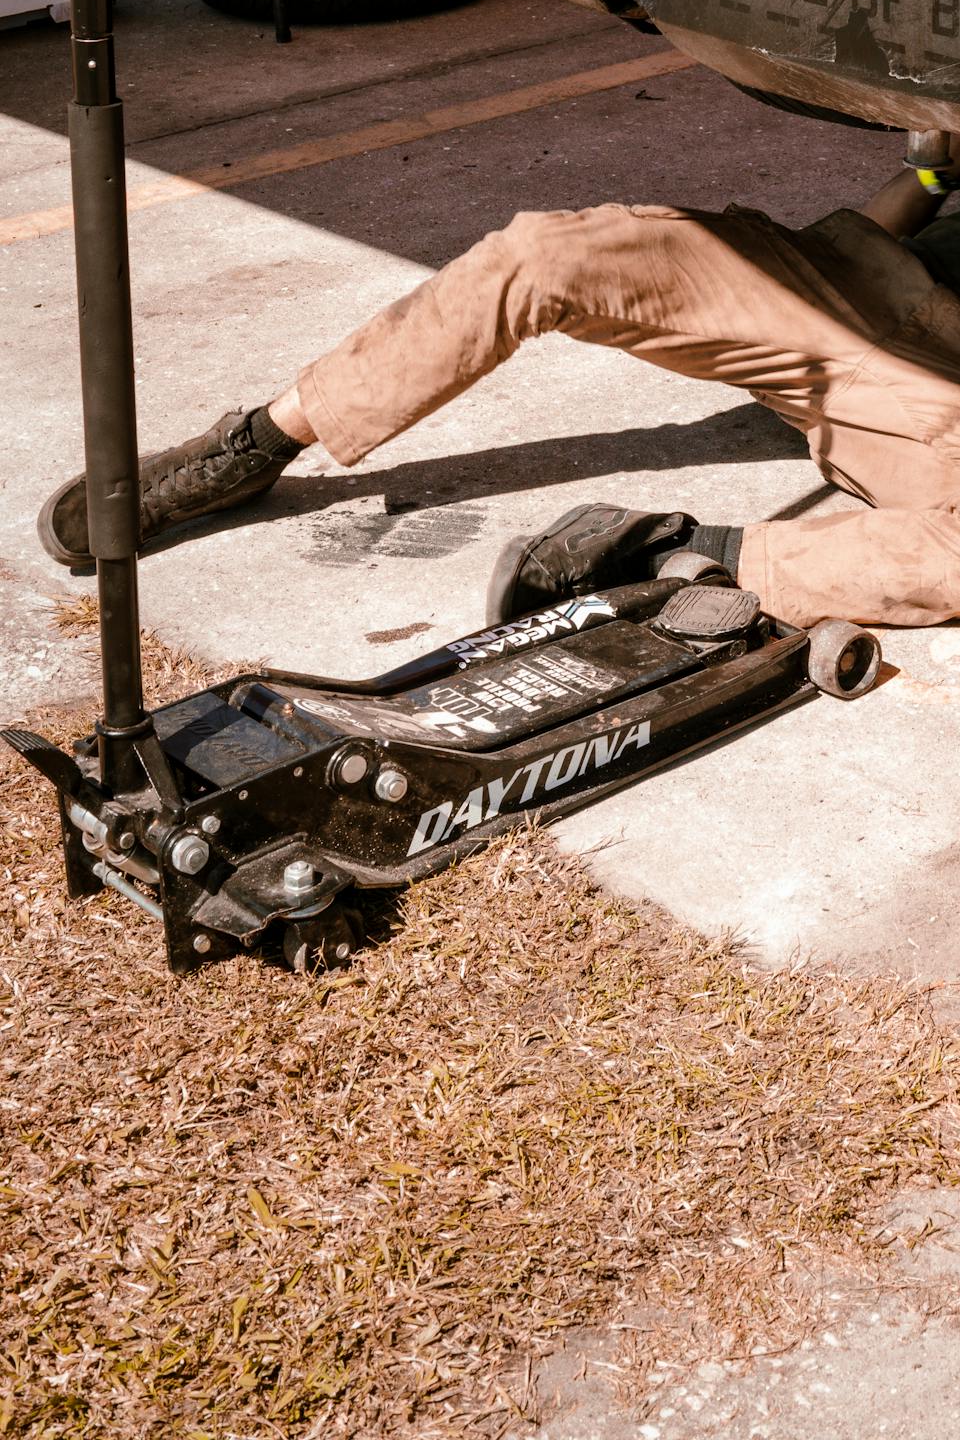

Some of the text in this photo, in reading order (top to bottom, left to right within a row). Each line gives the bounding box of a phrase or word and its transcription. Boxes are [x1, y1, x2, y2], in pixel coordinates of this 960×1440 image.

[446, 610, 562, 653] RACING
[457, 618, 573, 662] MEGAN
[470, 690, 514, 712] LOW
[474, 677, 542, 713] PROFILE
[406, 720, 651, 857] DAYTONA
